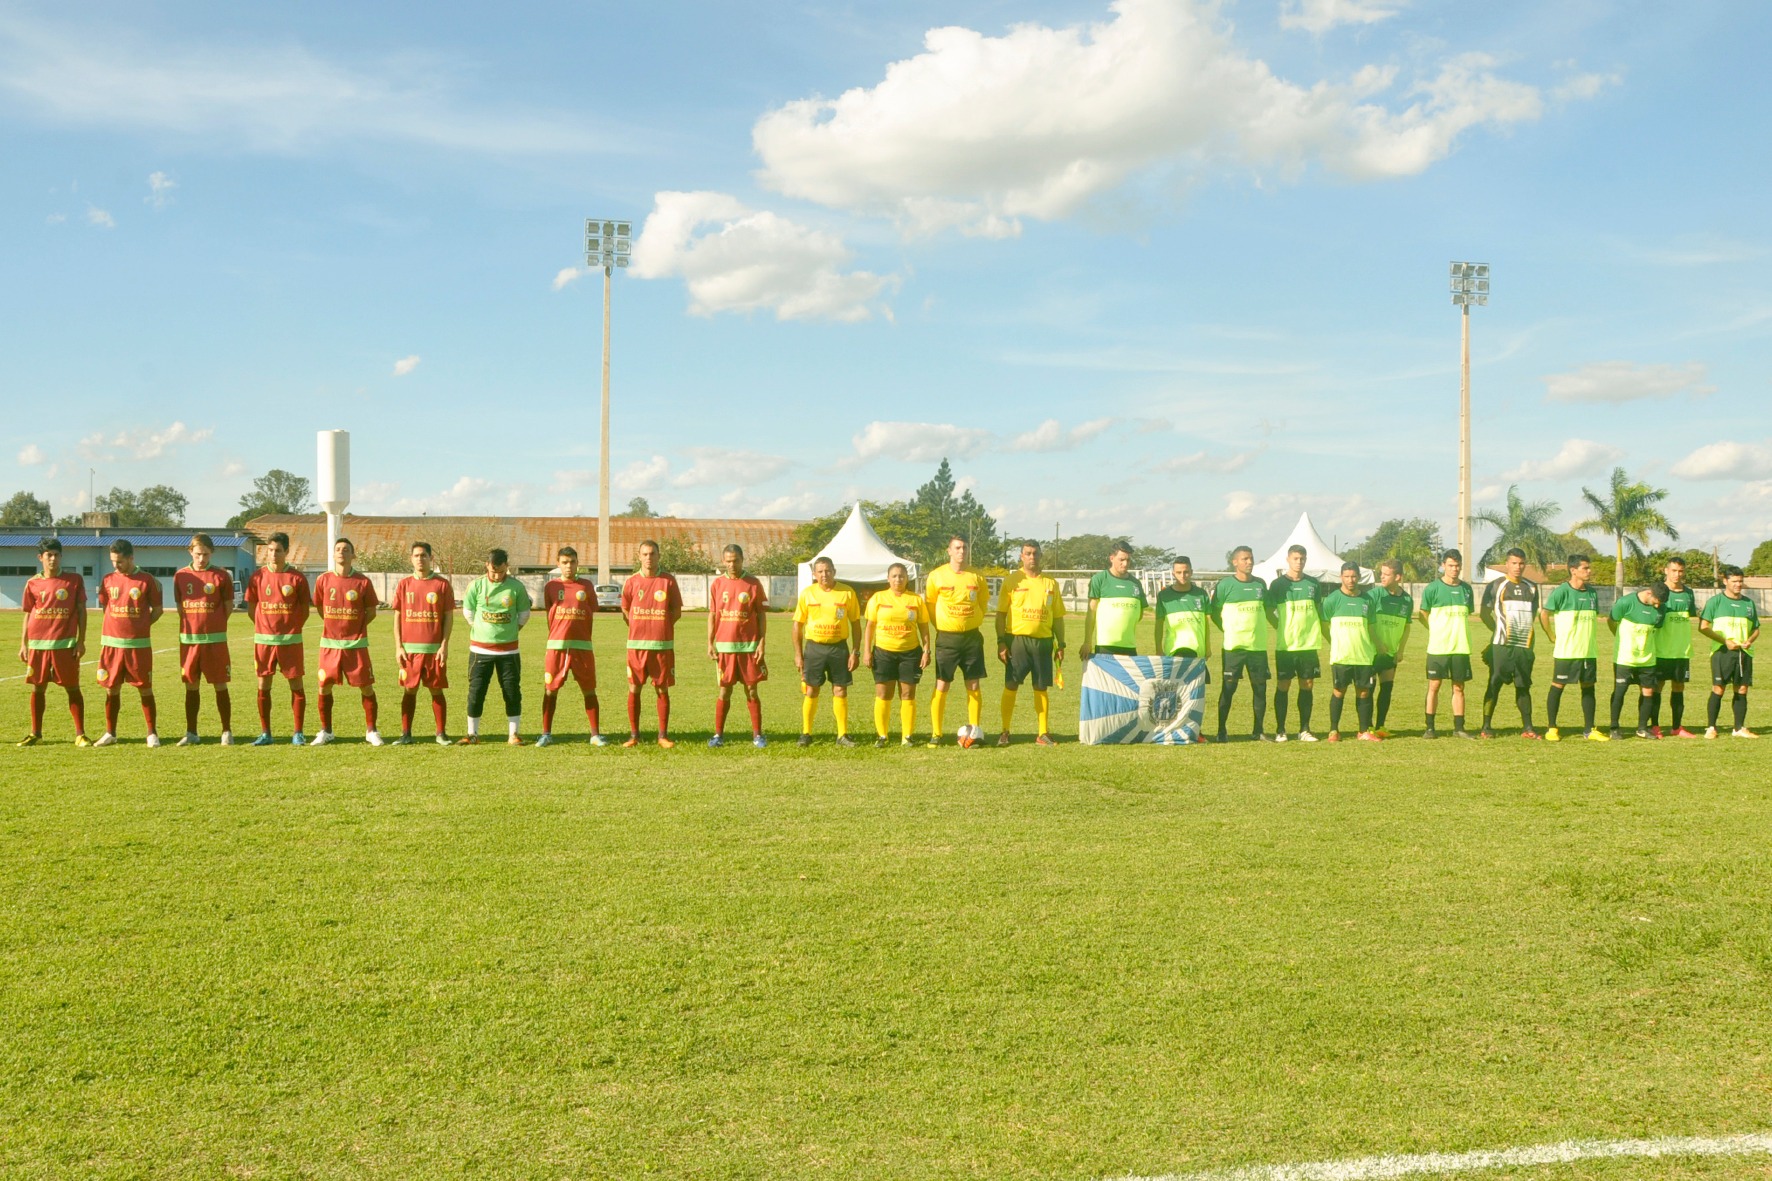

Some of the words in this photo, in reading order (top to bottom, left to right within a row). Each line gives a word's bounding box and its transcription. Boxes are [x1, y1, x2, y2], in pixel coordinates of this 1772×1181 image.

[109, 586, 119, 600] 10
[186, 583, 193, 595] 3
[265, 584, 272, 596] 6
[329, 588, 336, 601] 2
[405, 591, 415, 604] 11
[558, 590, 565, 601] 8
[637, 589, 644, 602] 9
[722, 591, 729, 603] 5
[182, 600, 215, 609] Usetec
[261, 601, 293, 609] Usetec
[325, 606, 358, 614] Usetec
[633, 606, 666, 615] Usetec
[406, 609, 439, 617] Usetec
